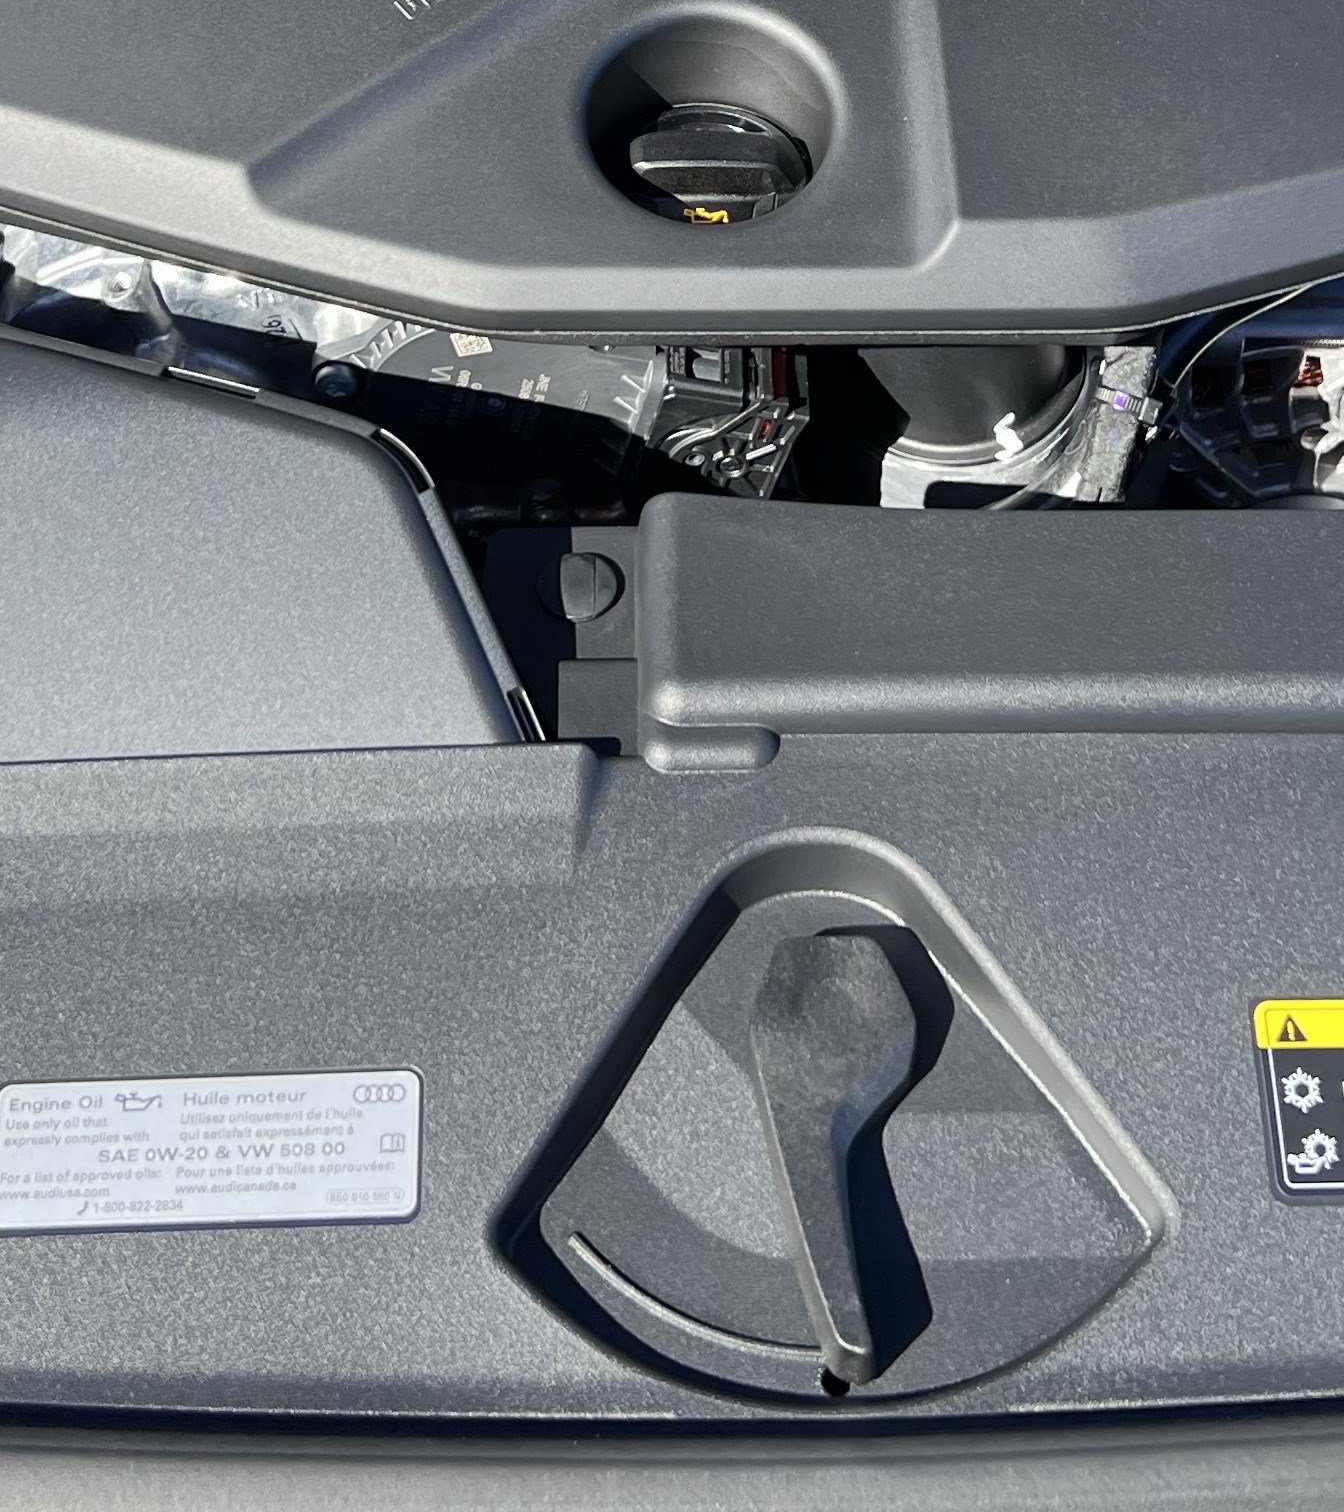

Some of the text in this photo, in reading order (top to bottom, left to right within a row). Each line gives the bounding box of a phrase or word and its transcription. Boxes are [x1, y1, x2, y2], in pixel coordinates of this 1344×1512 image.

[9, 1095, 102, 1113] Engine Oil
[183, 1091, 307, 1106] Huile moteur
[6, 1117, 107, 1131] Use only oil that
[180, 1113, 225, 1124] Utilisez
[229, 1111, 303, 1124] uniquement
[307, 1109, 321, 1120] de
[4, 1130, 149, 1148] expressly complies with
[180, 1129, 199, 1141] qui
[203, 1128, 252, 1140] satisfait
[99, 1142, 345, 1163] SAE 0W-20 & VW 508 00
[0, 1173, 20, 1184] For
[23, 1175, 30, 1183] a
[35, 1171, 53, 1182] list
[57, 1170, 69, 1181] of
[72, 1169, 131, 1183] approved
[176, 1166, 205, 1178] Pour
[210, 1167, 232, 1178] une
[237, 1165, 262, 1176] liste
